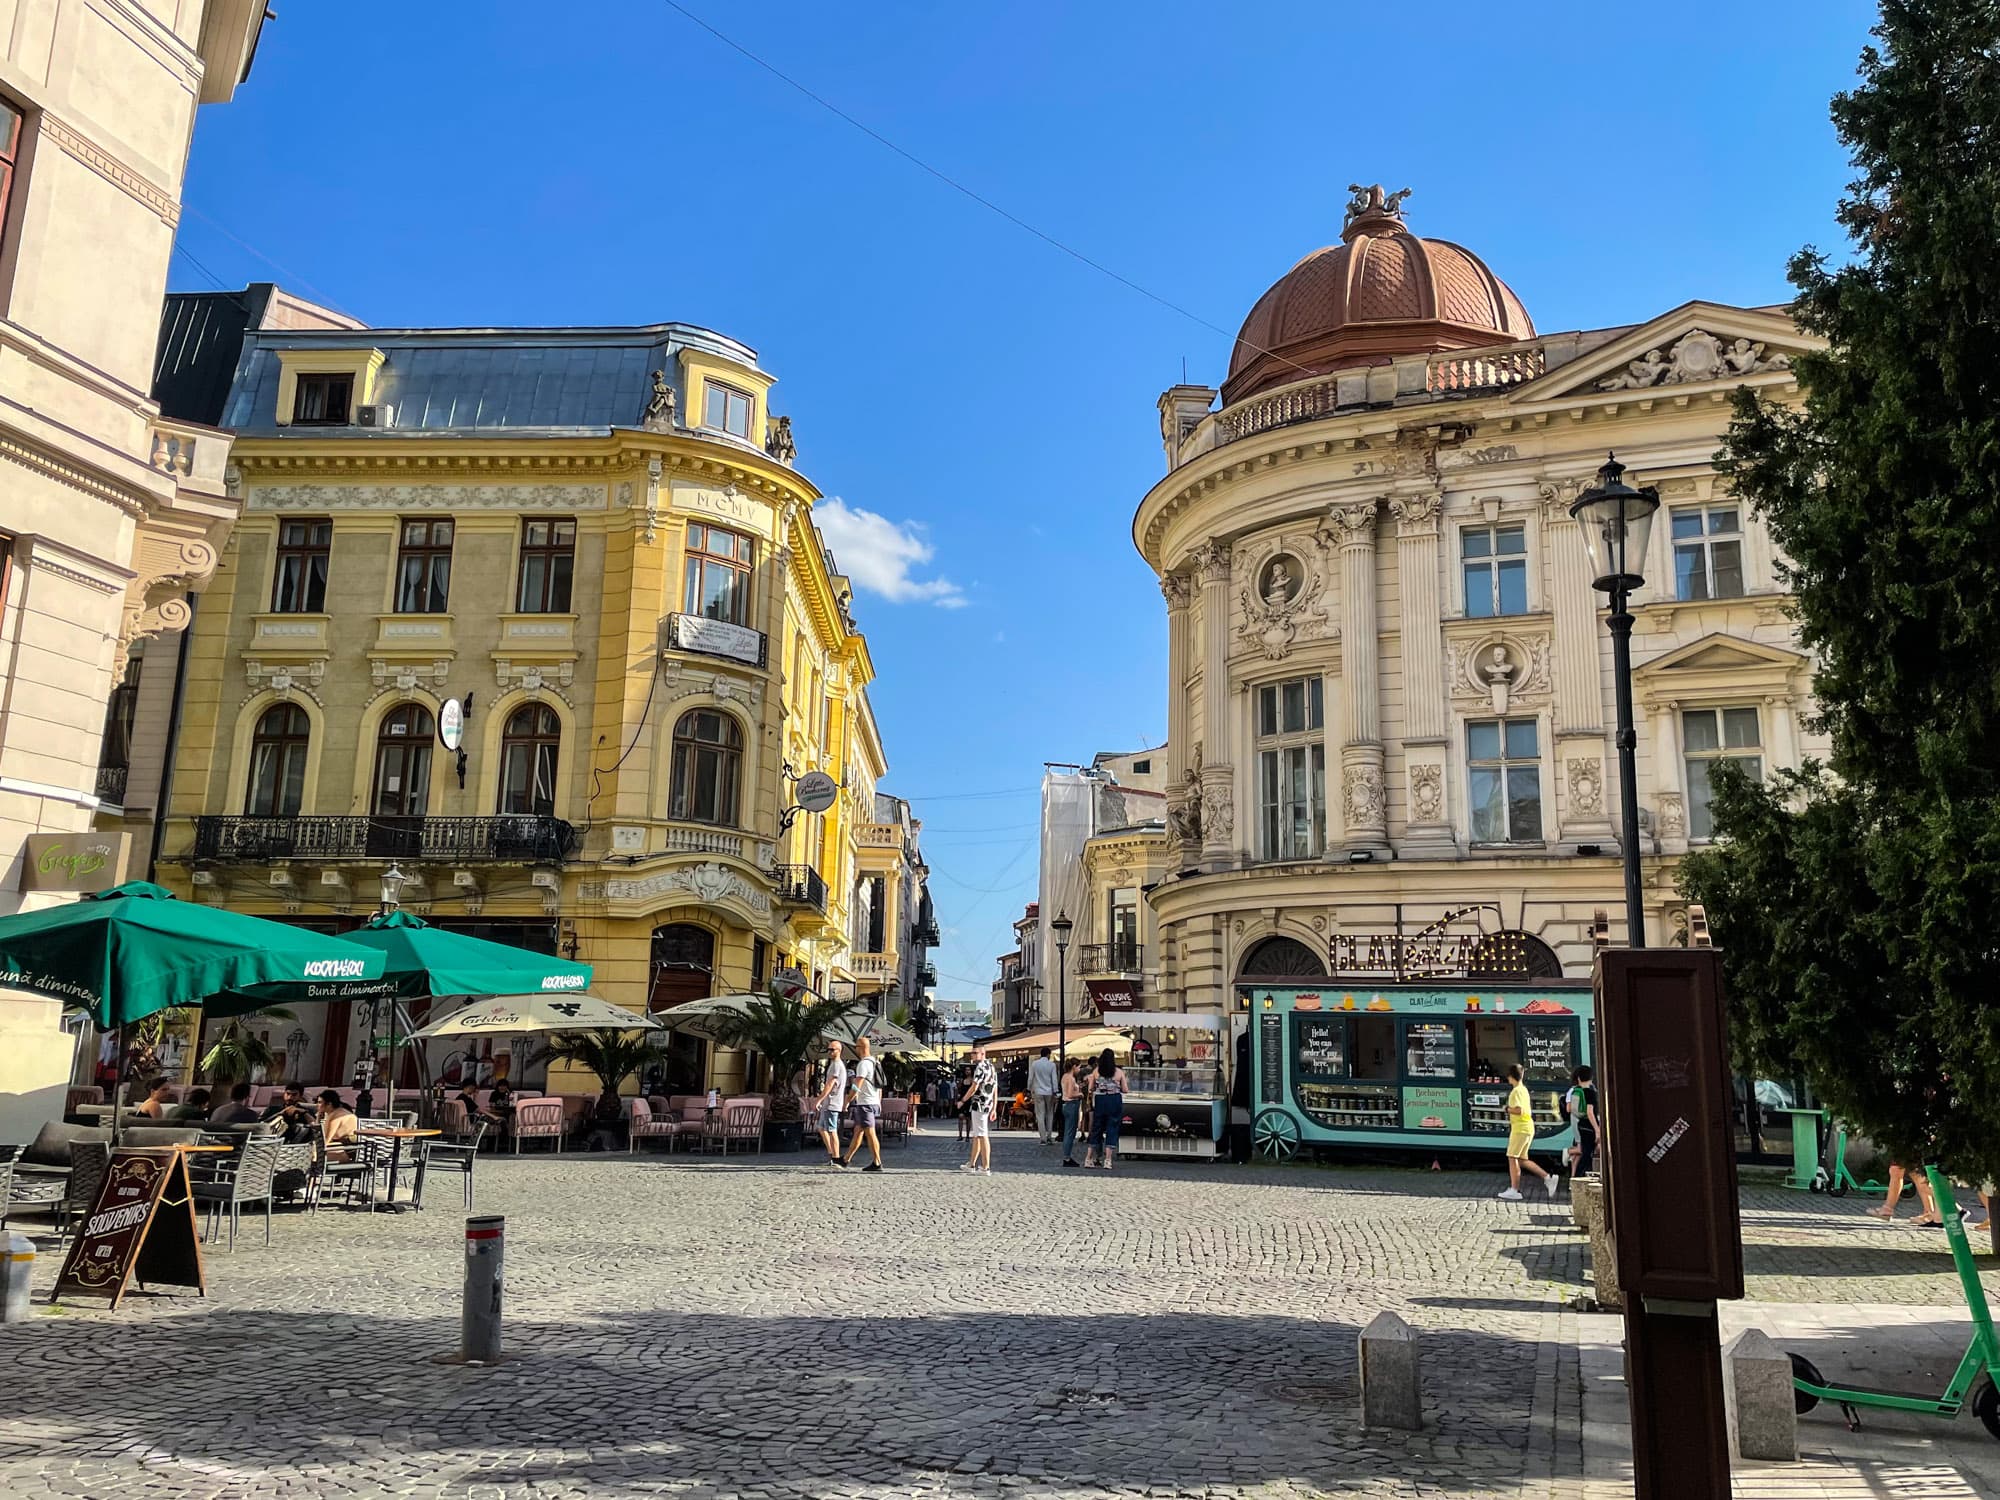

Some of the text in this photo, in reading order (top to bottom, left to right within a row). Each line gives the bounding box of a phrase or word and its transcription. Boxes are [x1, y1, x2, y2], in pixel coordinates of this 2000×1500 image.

[307, 984, 337, 997] Bună
[460, 1013, 520, 1028] Carlsberg
[1526, 1037, 1548, 1048] Collect
[1527, 1047, 1546, 1057] order
[1528, 1058, 1550, 1069] Thank
[85, 1202, 151, 1237] SOUVENIRS
